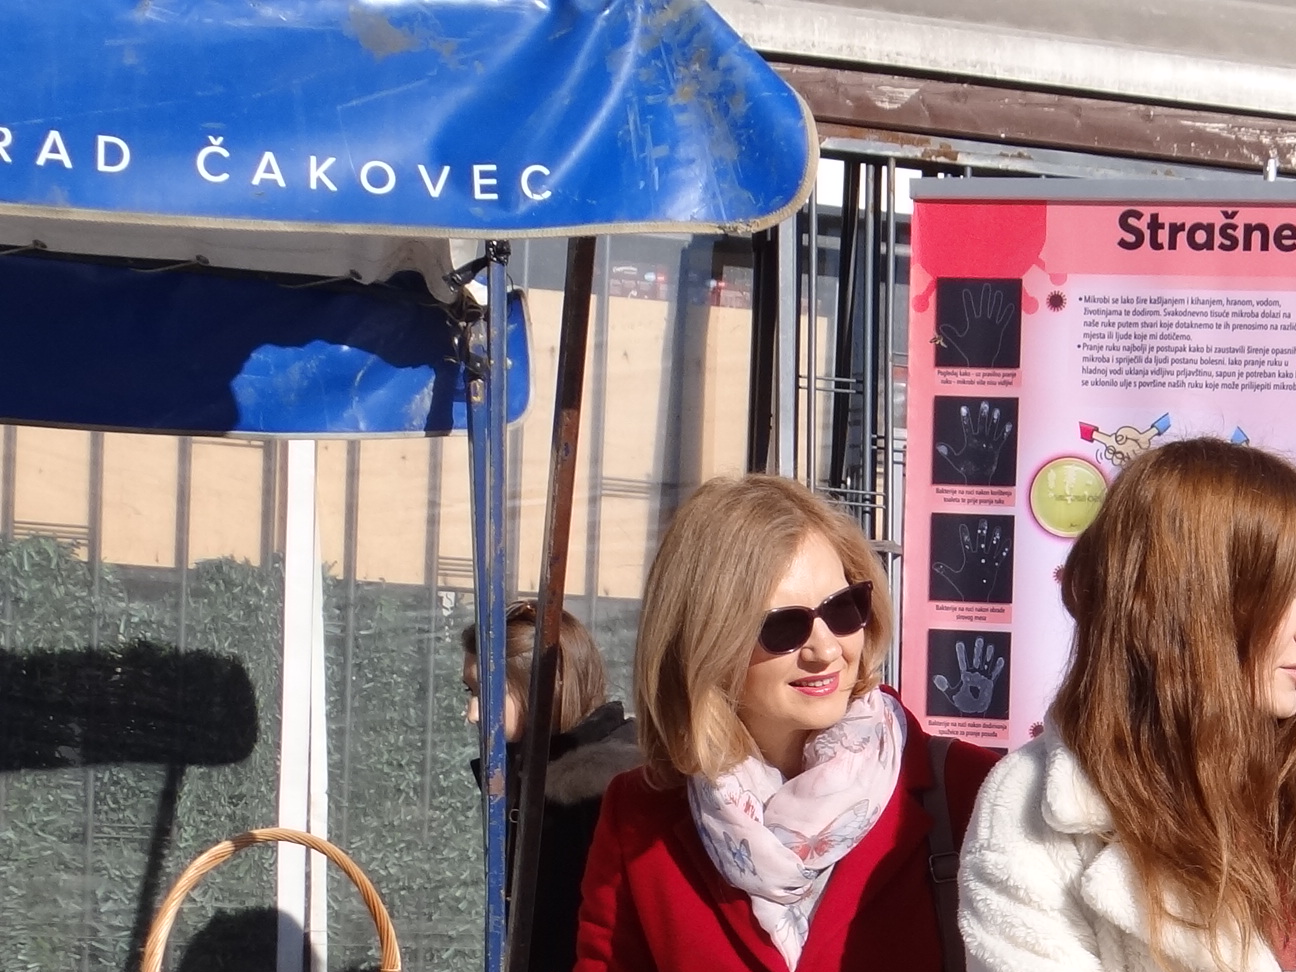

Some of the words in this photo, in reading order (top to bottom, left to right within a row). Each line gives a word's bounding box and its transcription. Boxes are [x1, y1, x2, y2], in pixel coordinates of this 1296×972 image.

[195, 136, 553, 201] ČAKOVEC
[1121, 296, 1134, 305] lako
[1136, 296, 1147, 305] šire
[1124, 307, 1130, 316] te
[1084, 318, 1099, 327] naše
[1101, 319, 1115, 328] ruke
[1160, 320, 1173, 331] koje
[1216, 320, 1222, 329] te
[1224, 321, 1230, 329] ih
[1134, 331, 1147, 342] koje
[1149, 331, 1158, 340] mi
